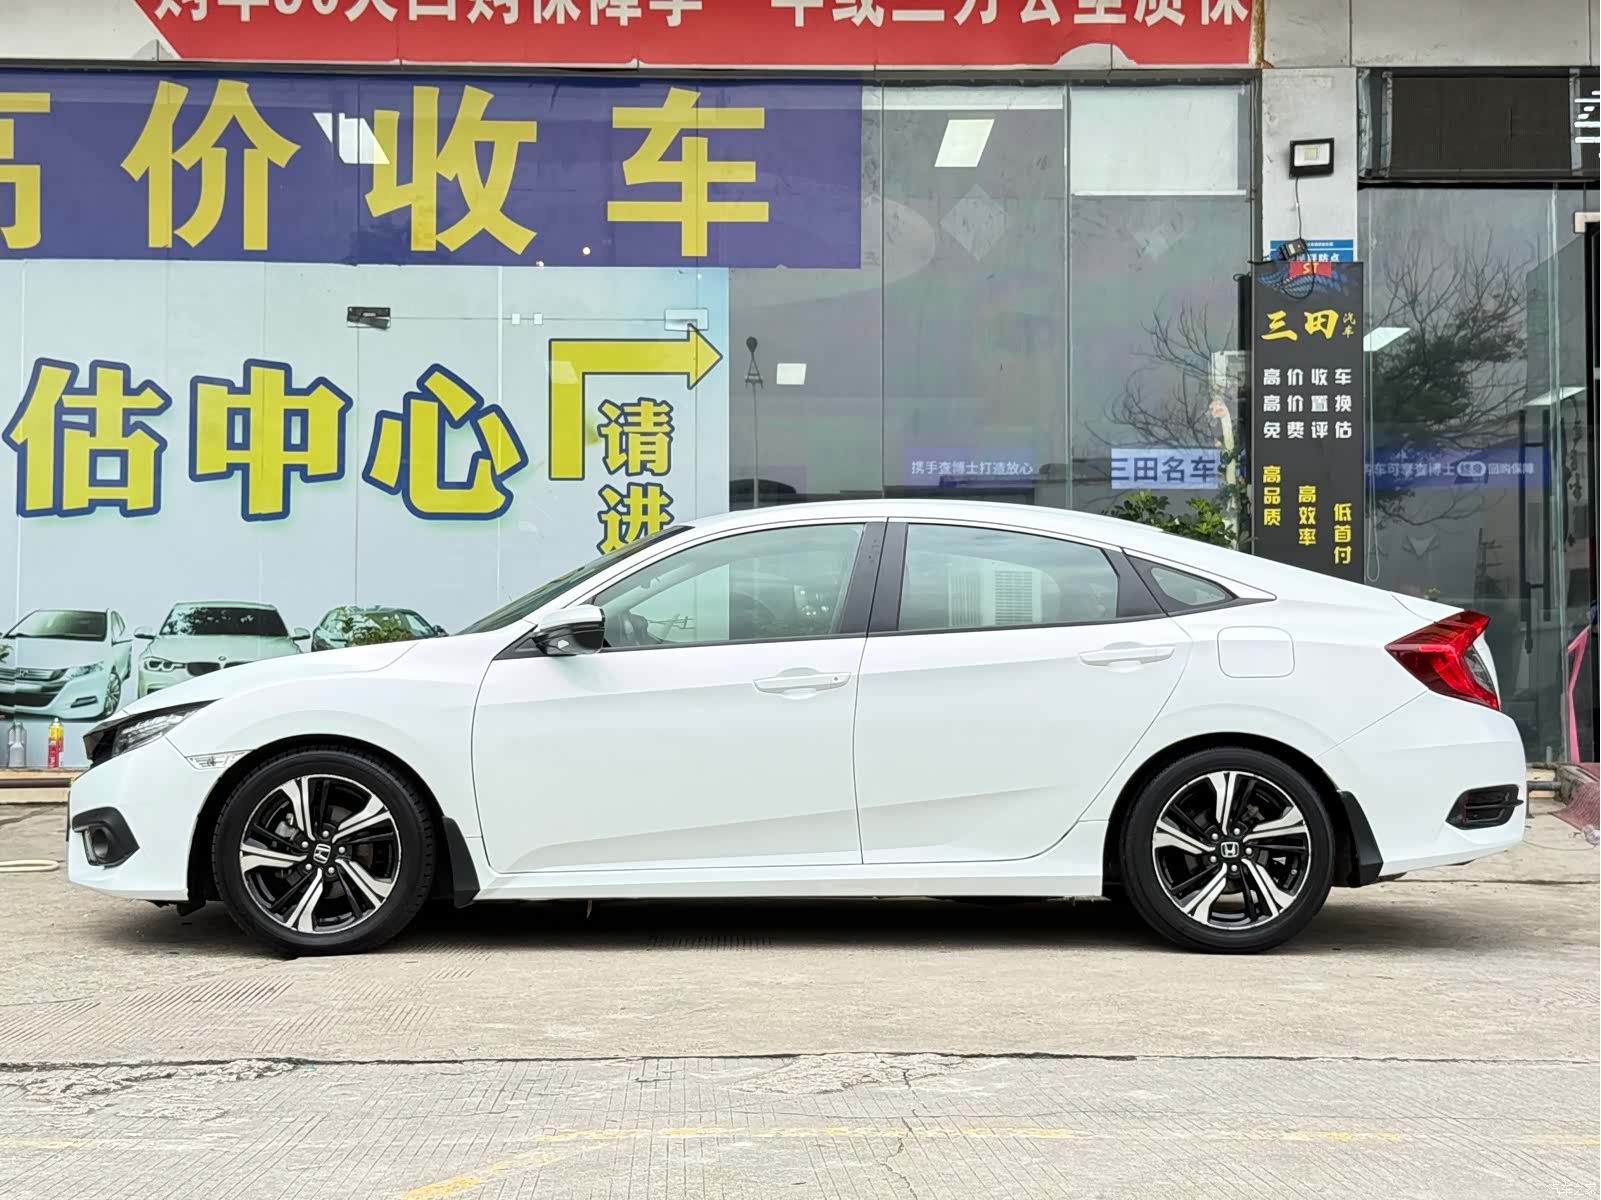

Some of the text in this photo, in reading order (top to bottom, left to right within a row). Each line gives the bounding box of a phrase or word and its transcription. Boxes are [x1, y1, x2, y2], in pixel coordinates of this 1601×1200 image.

[1261, 309, 1339, 342] 三田
[1263, 368, 1352, 386] 高价收车
[1263, 395, 1352, 413] 高价置换
[2, 357, 528, 521] 估中心
[1263, 421, 1352, 439] 免费评估
[1110, 456, 1217, 483] 三田名车
[1263, 465, 1282, 526] 高品质
[1298, 485, 1317, 546] 高效率
[1333, 503, 1352, 565] 低首付
